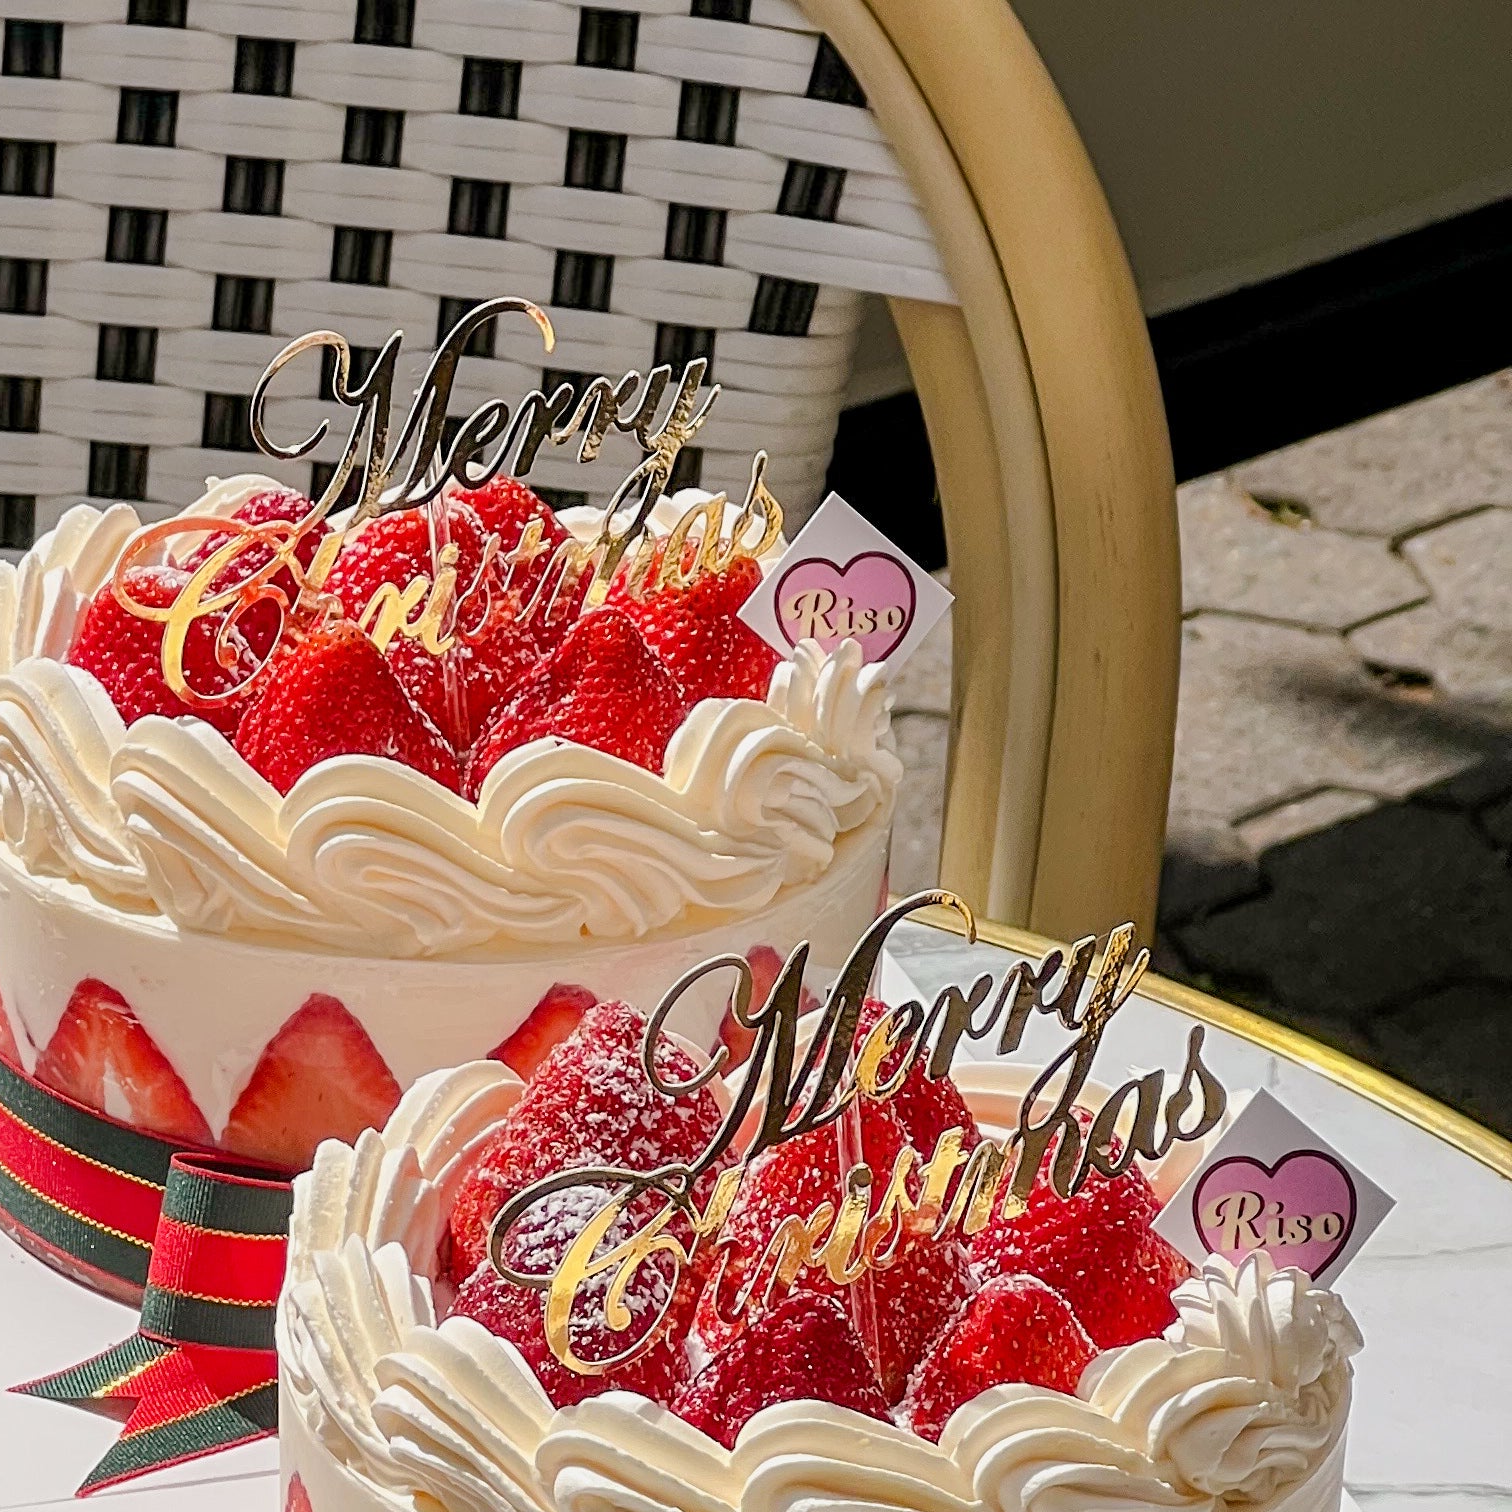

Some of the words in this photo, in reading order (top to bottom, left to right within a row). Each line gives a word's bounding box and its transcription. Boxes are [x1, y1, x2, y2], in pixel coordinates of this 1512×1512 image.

[251, 296, 723, 537] Merry
[114, 449, 785, 708] Christmas
[782, 587, 906, 639] Riso
[641, 888, 1151, 1137] Merry
[490, 1024, 1226, 1375] Christmas
[1202, 1190, 1345, 1251] Riso
